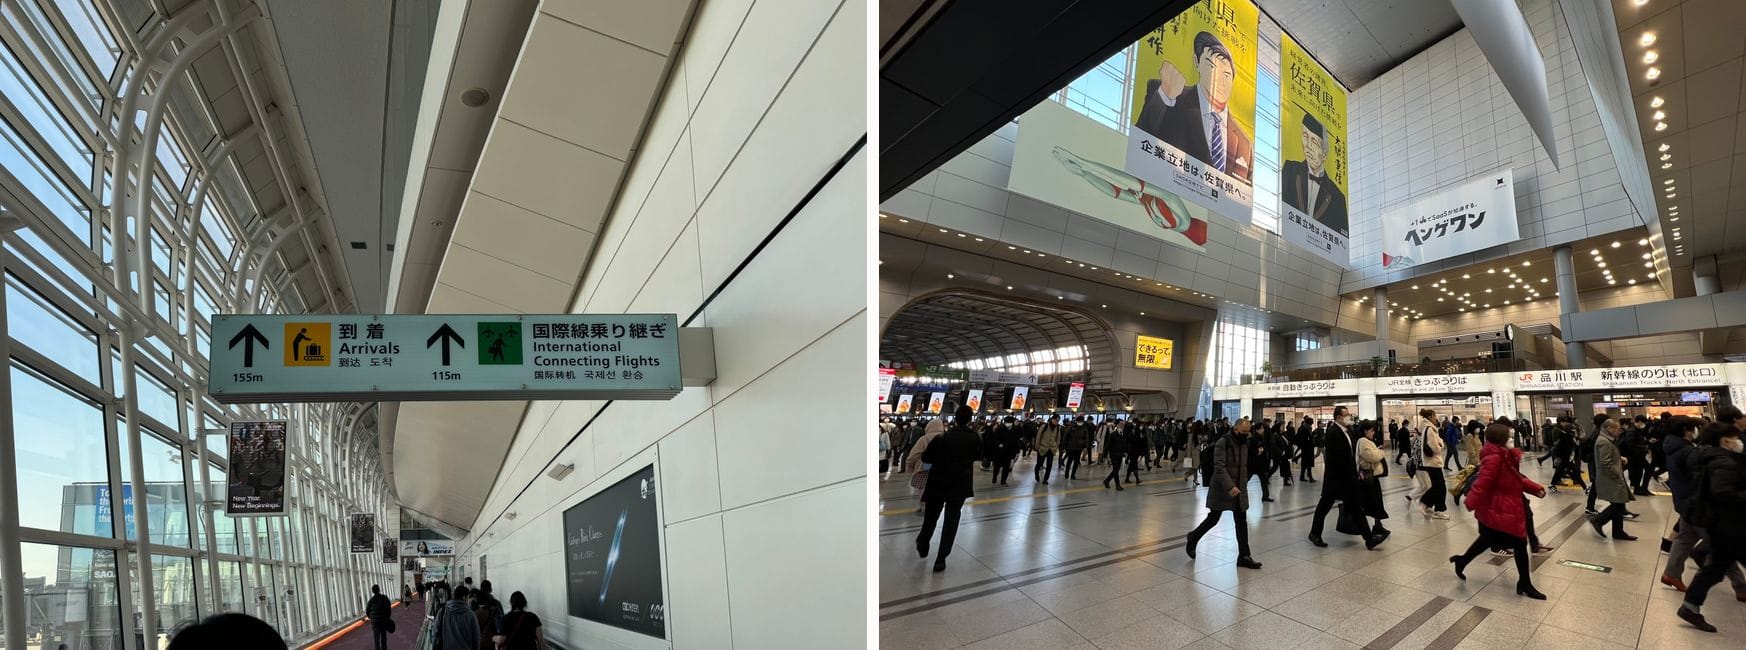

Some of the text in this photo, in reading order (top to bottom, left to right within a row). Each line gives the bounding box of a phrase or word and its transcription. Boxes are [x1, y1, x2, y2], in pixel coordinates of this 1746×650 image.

[1141, 139, 1246, 201] 企業立地は、佐賀県へ。
[1288, 211, 1346, 249] 企業立地は、佐賀県へ。
[1405, 211, 1487, 246] ヘンゲワン
[339, 323, 385, 340] 到着
[532, 322, 667, 340] 国際線乗り継ぎ
[339, 342, 400, 355] Arrivals
[533, 341, 621, 352] International
[339, 357, 393, 368] 到达 도착
[534, 355, 660, 369] Connecting Flights
[232, 372, 263, 382] 155m
[431, 371, 461, 381] 115m
[534, 371, 643, 380] 国际转机 국제선 환승
[1520, 373, 1533, 381] JR
[1541, 372, 1583, 382] 品川駅
[247, 502, 281, 510] Beginnings.
